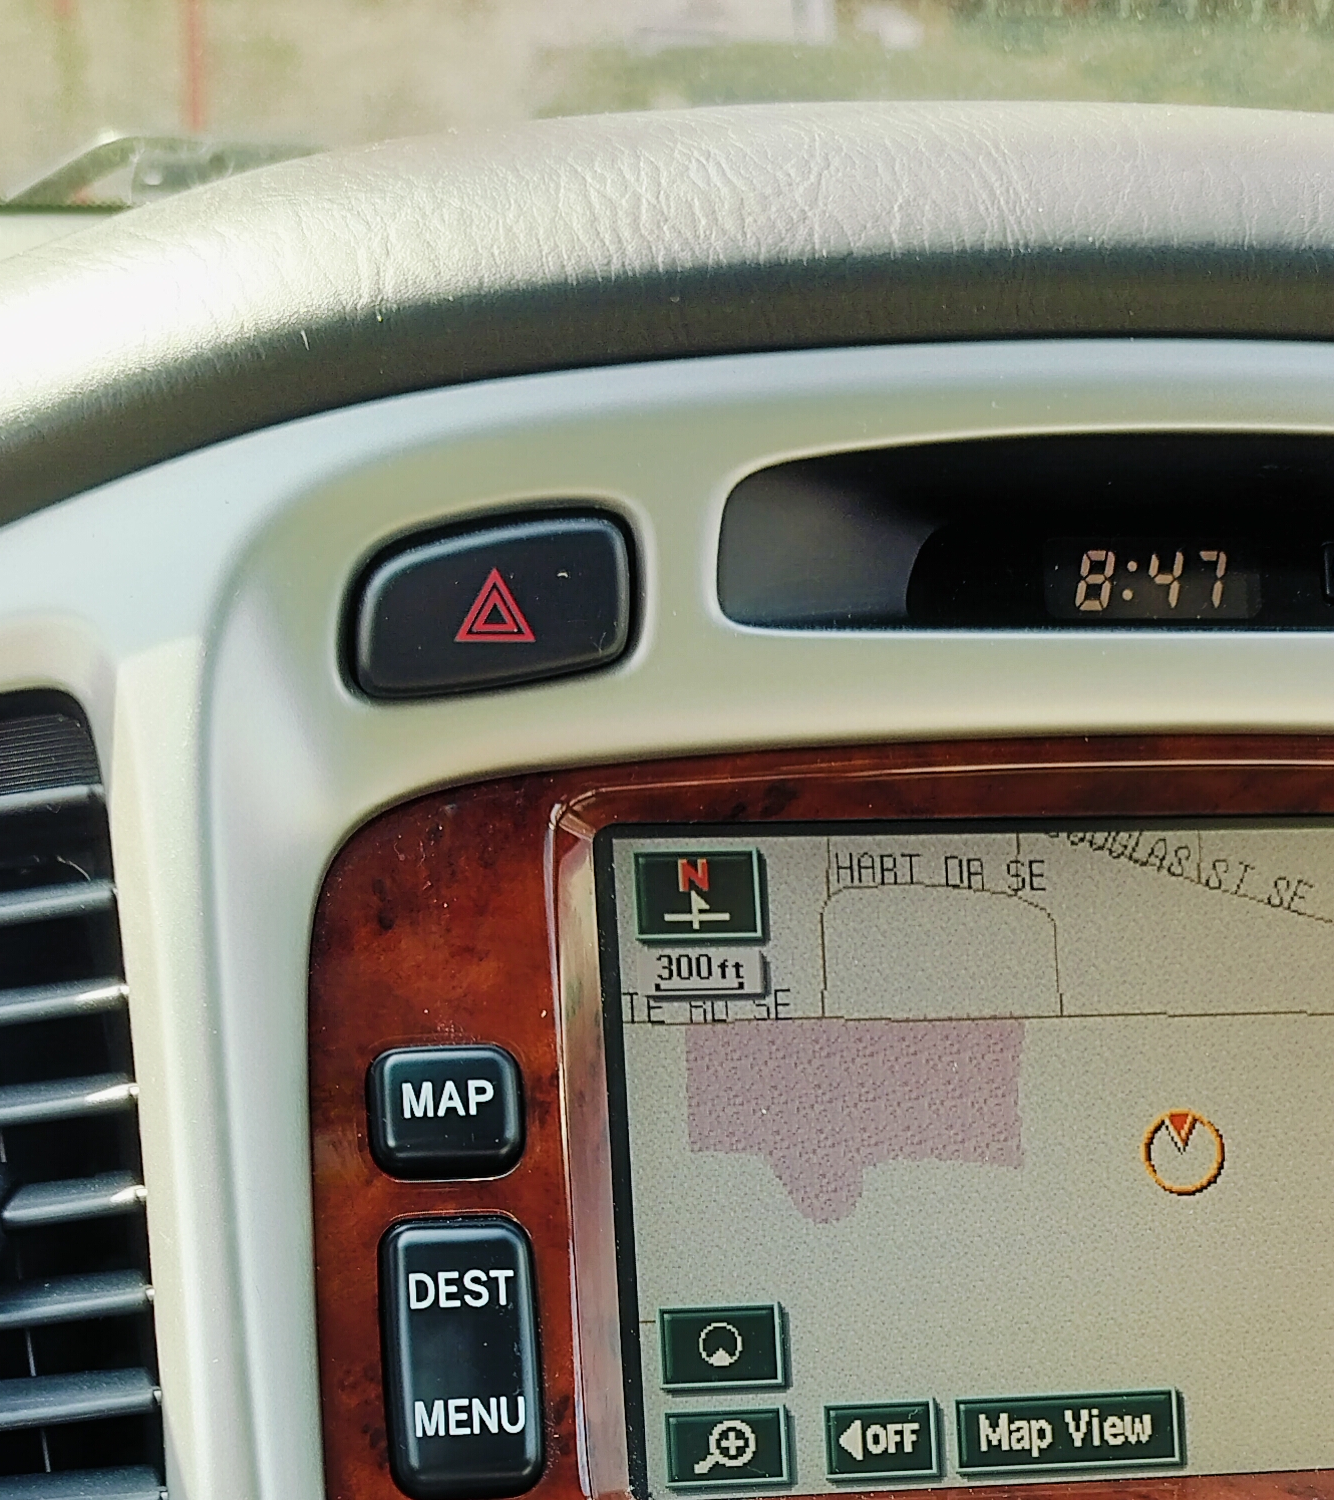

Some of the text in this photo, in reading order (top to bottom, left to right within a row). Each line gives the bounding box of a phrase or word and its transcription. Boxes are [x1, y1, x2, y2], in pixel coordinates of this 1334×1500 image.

[1076, 549, 1229, 612] 8:47
[677, 858, 710, 892] N
[834, 851, 921, 886] HART
[401, 1079, 495, 1119] MAP
[408, 1269, 514, 1310] DEST
[414, 1396, 526, 1438] MENU
[979, 1408, 1152, 1457] Map View
[866, 1421, 920, 1455] OFF
